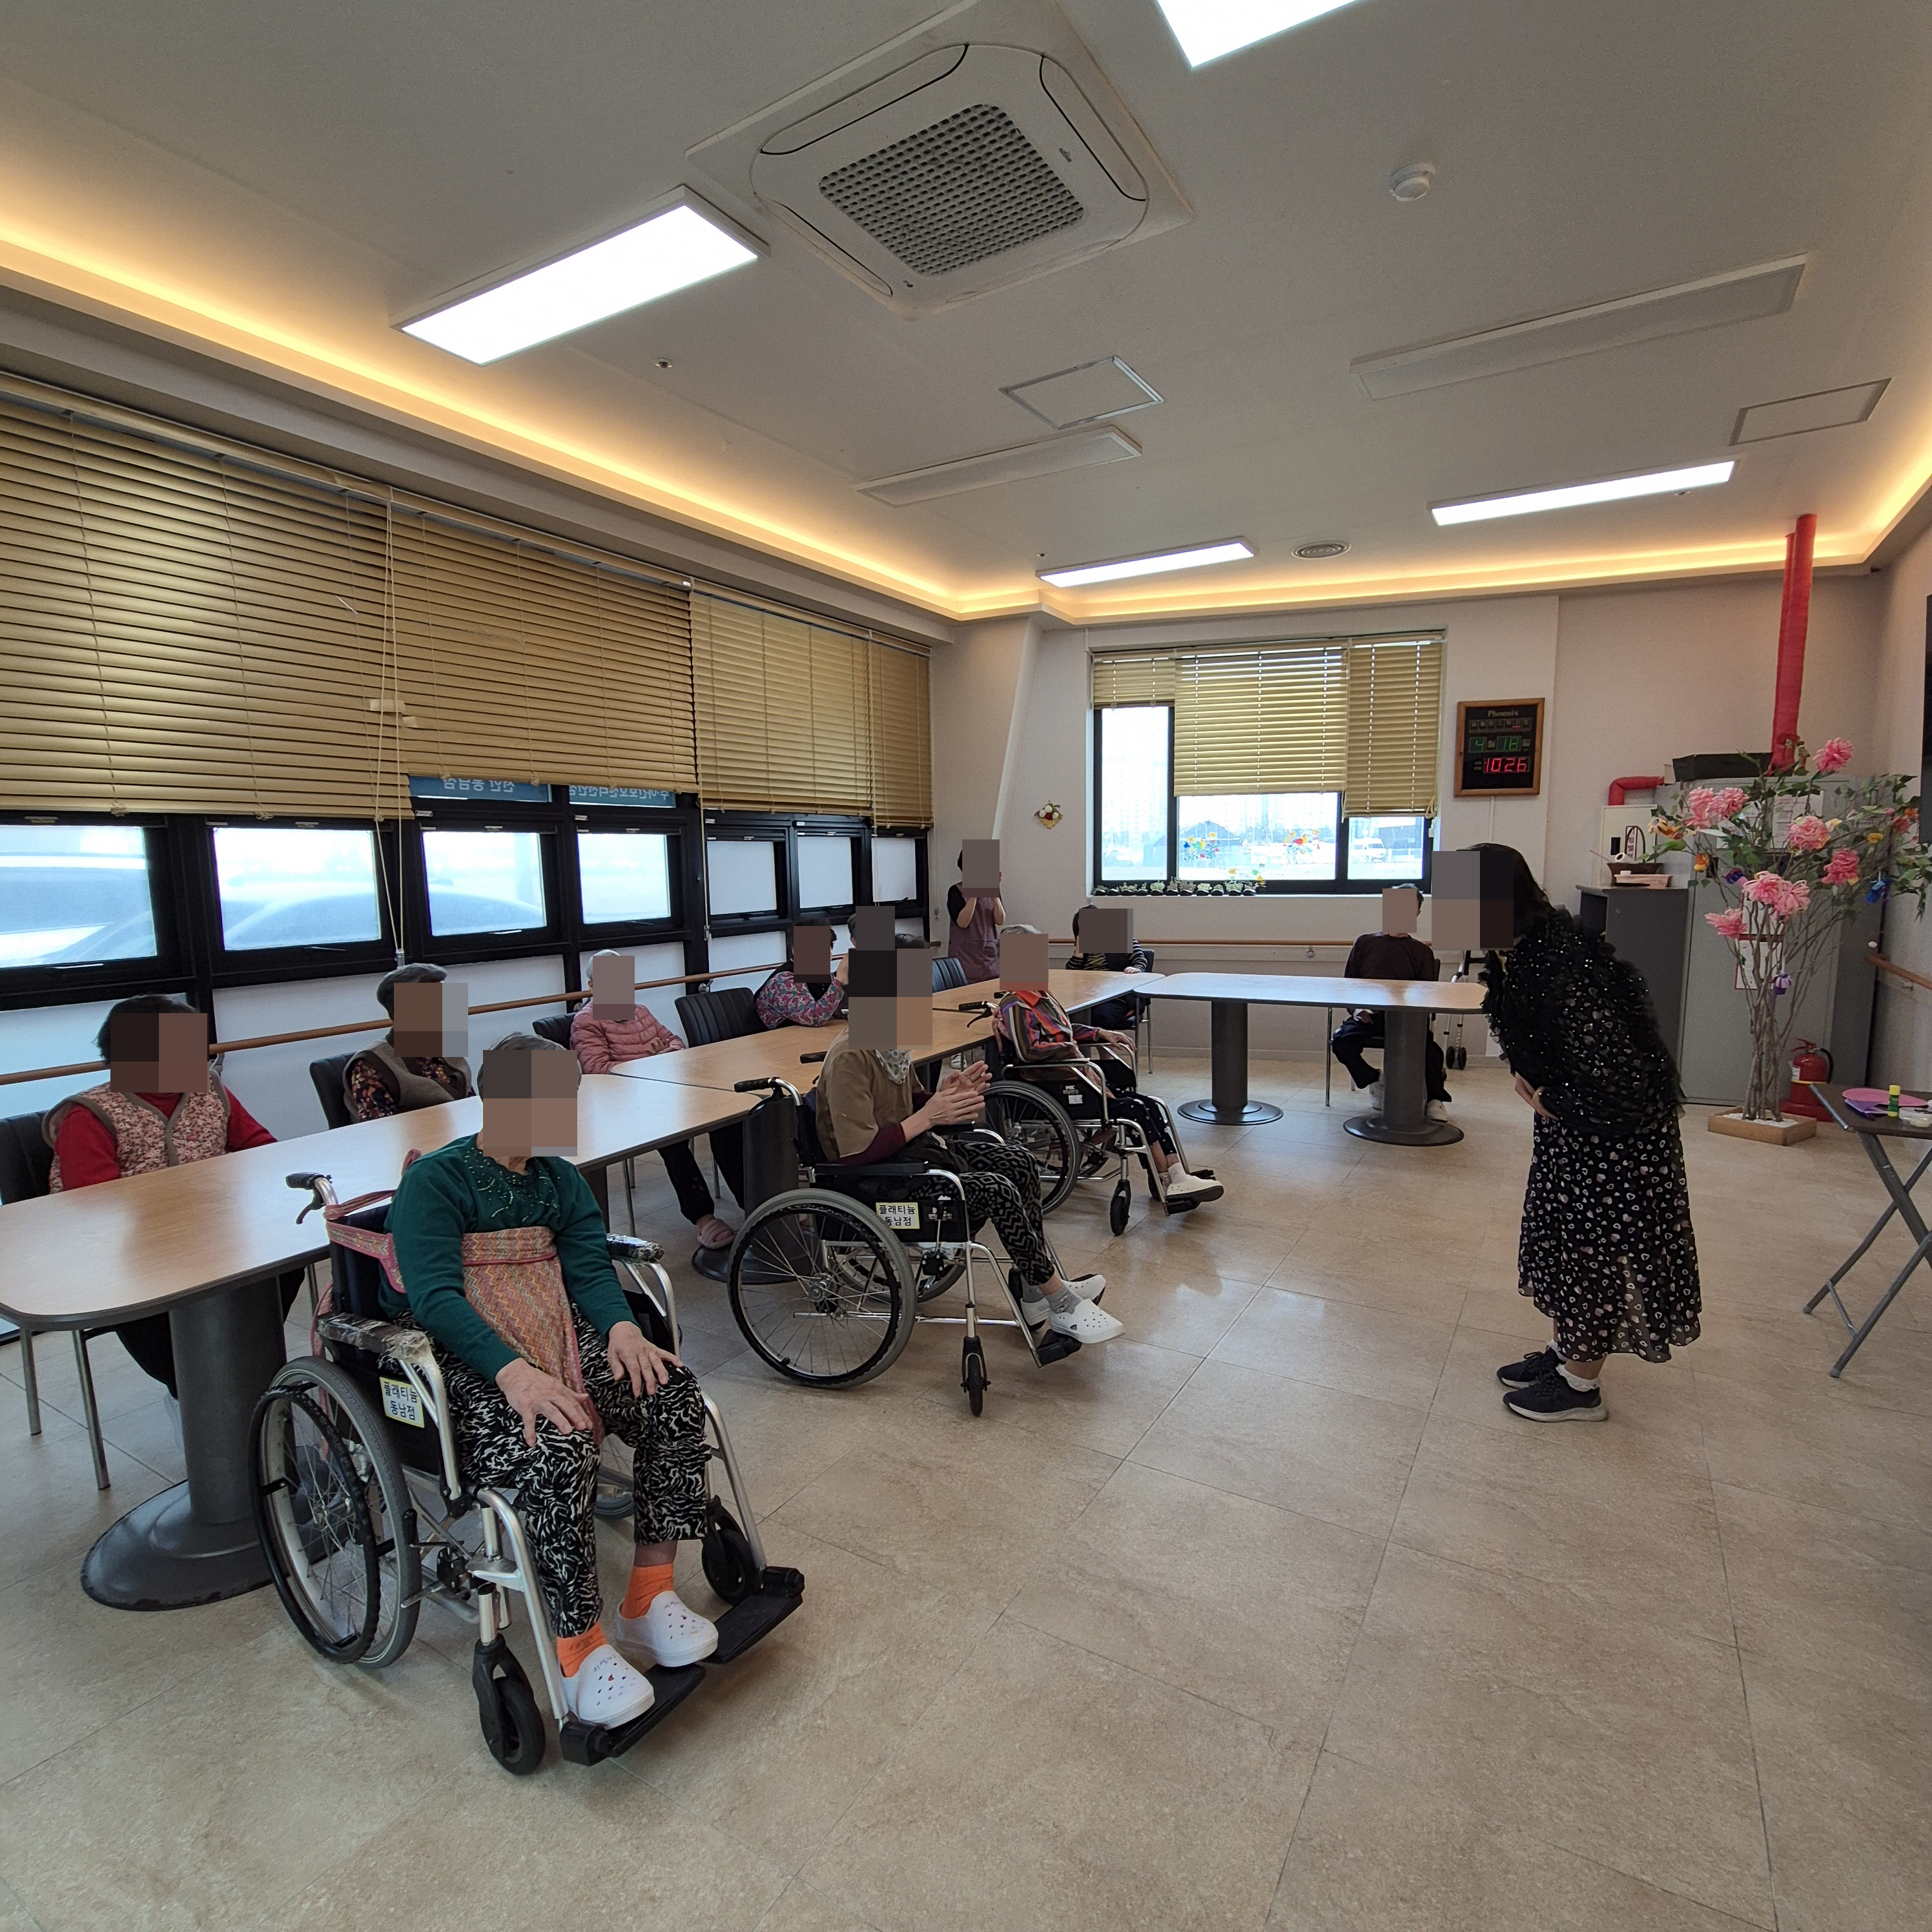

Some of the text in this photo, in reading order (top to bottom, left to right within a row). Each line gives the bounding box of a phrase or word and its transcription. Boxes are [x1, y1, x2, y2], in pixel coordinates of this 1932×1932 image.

[1475, 737, 1485, 752] 4
[879, 1204, 915, 1215] 플래티늄
[884, 1217, 911, 1226] 동남점
[384, 1381, 418, 1403] 플래티늄
[390, 1401, 415, 1421] 동남점
